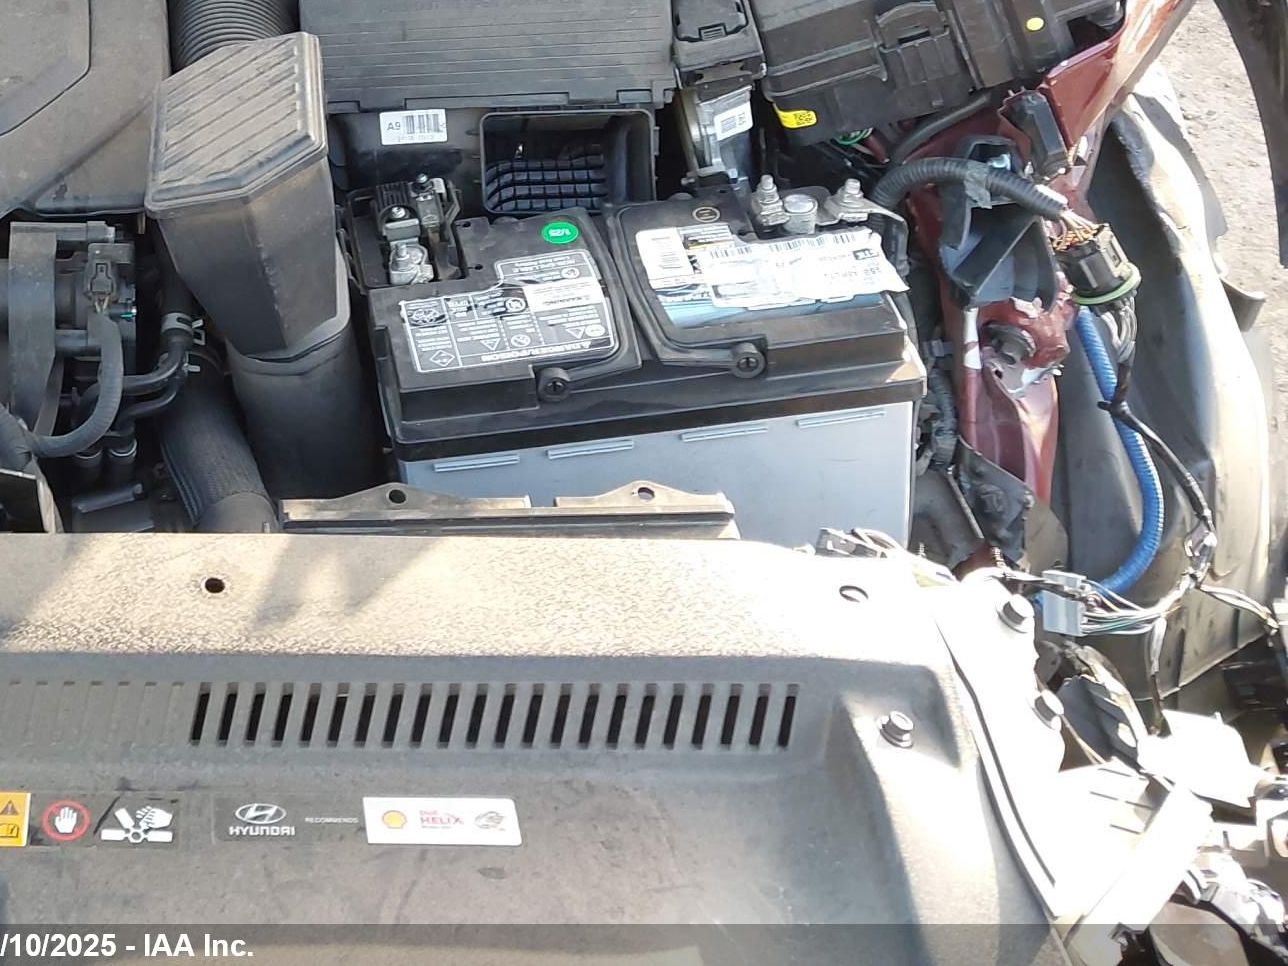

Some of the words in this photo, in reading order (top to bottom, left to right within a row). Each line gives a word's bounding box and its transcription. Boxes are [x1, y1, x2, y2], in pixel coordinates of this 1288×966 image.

[387, 121, 401, 131] A9
[419, 815, 464, 825] HELIX
[228, 825, 296, 836] HYUNDAI
